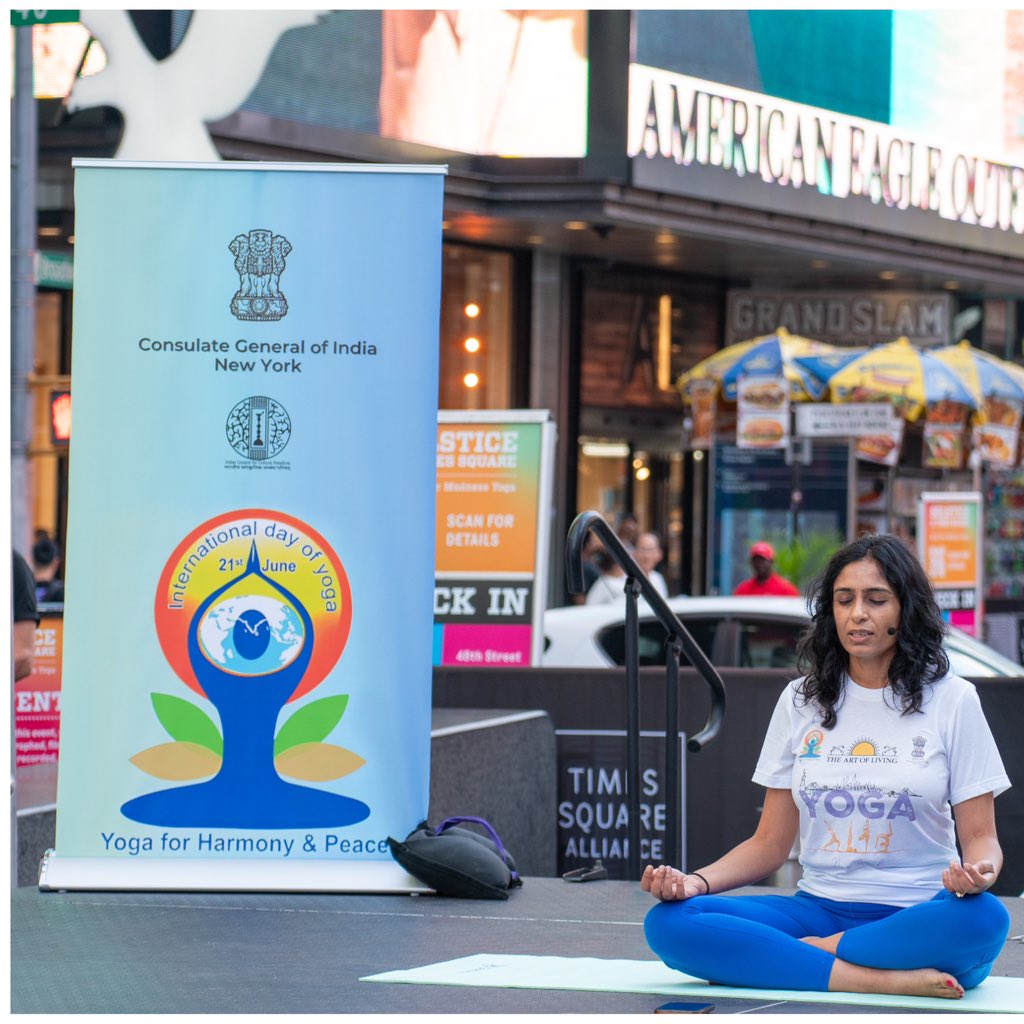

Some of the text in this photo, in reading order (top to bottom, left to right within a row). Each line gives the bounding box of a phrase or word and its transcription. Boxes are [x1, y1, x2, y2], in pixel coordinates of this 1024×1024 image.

[639, 79, 837, 192] AMERICAN
[848, 126, 943, 210] EAGLE
[138, 337, 377, 355] Consulate General of India
[214, 358, 302, 373] New York
[446, 514, 515, 528] SCAN FOR
[446, 533, 501, 547] DETAILS
[168, 520, 338, 613] International day of yoga
[218, 558, 297, 573] 21st June
[487, 587, 529, 617] IN
[844, 756, 859, 764] ART
[567, 767, 660, 796] TIMS
[799, 788, 916, 822] YOGA
[101, 832, 389, 857] Yoga for Harmony & Peace
